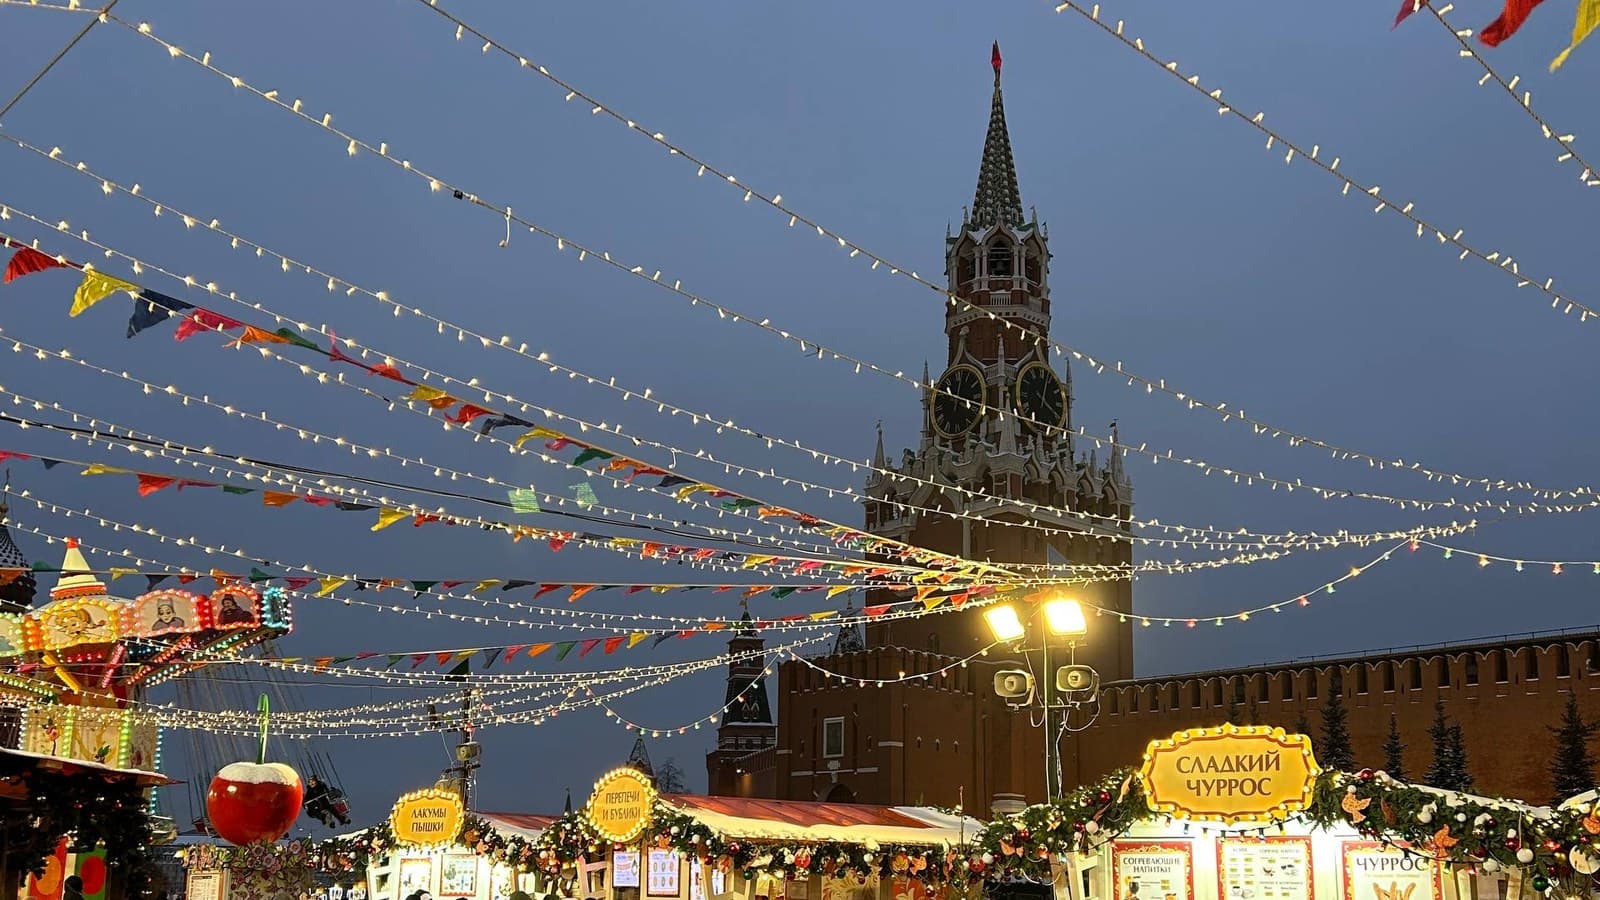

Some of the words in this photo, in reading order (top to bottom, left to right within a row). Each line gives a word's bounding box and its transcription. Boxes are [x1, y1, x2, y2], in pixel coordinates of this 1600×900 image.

[1176, 750, 1280, 774] СЛАДКИЙ
[1186, 777, 1272, 796] ЧУРРОС
[605, 791, 640, 804] ПЕРЕПЕЧИ
[411, 808, 447, 818] ЛАКУМЫ
[602, 809, 609, 820] И
[610, 807, 641, 820] БУБЛИКИ
[411, 822, 444, 832] ПЫШКИ
[1356, 857, 1429, 871] ЧУРРОС
